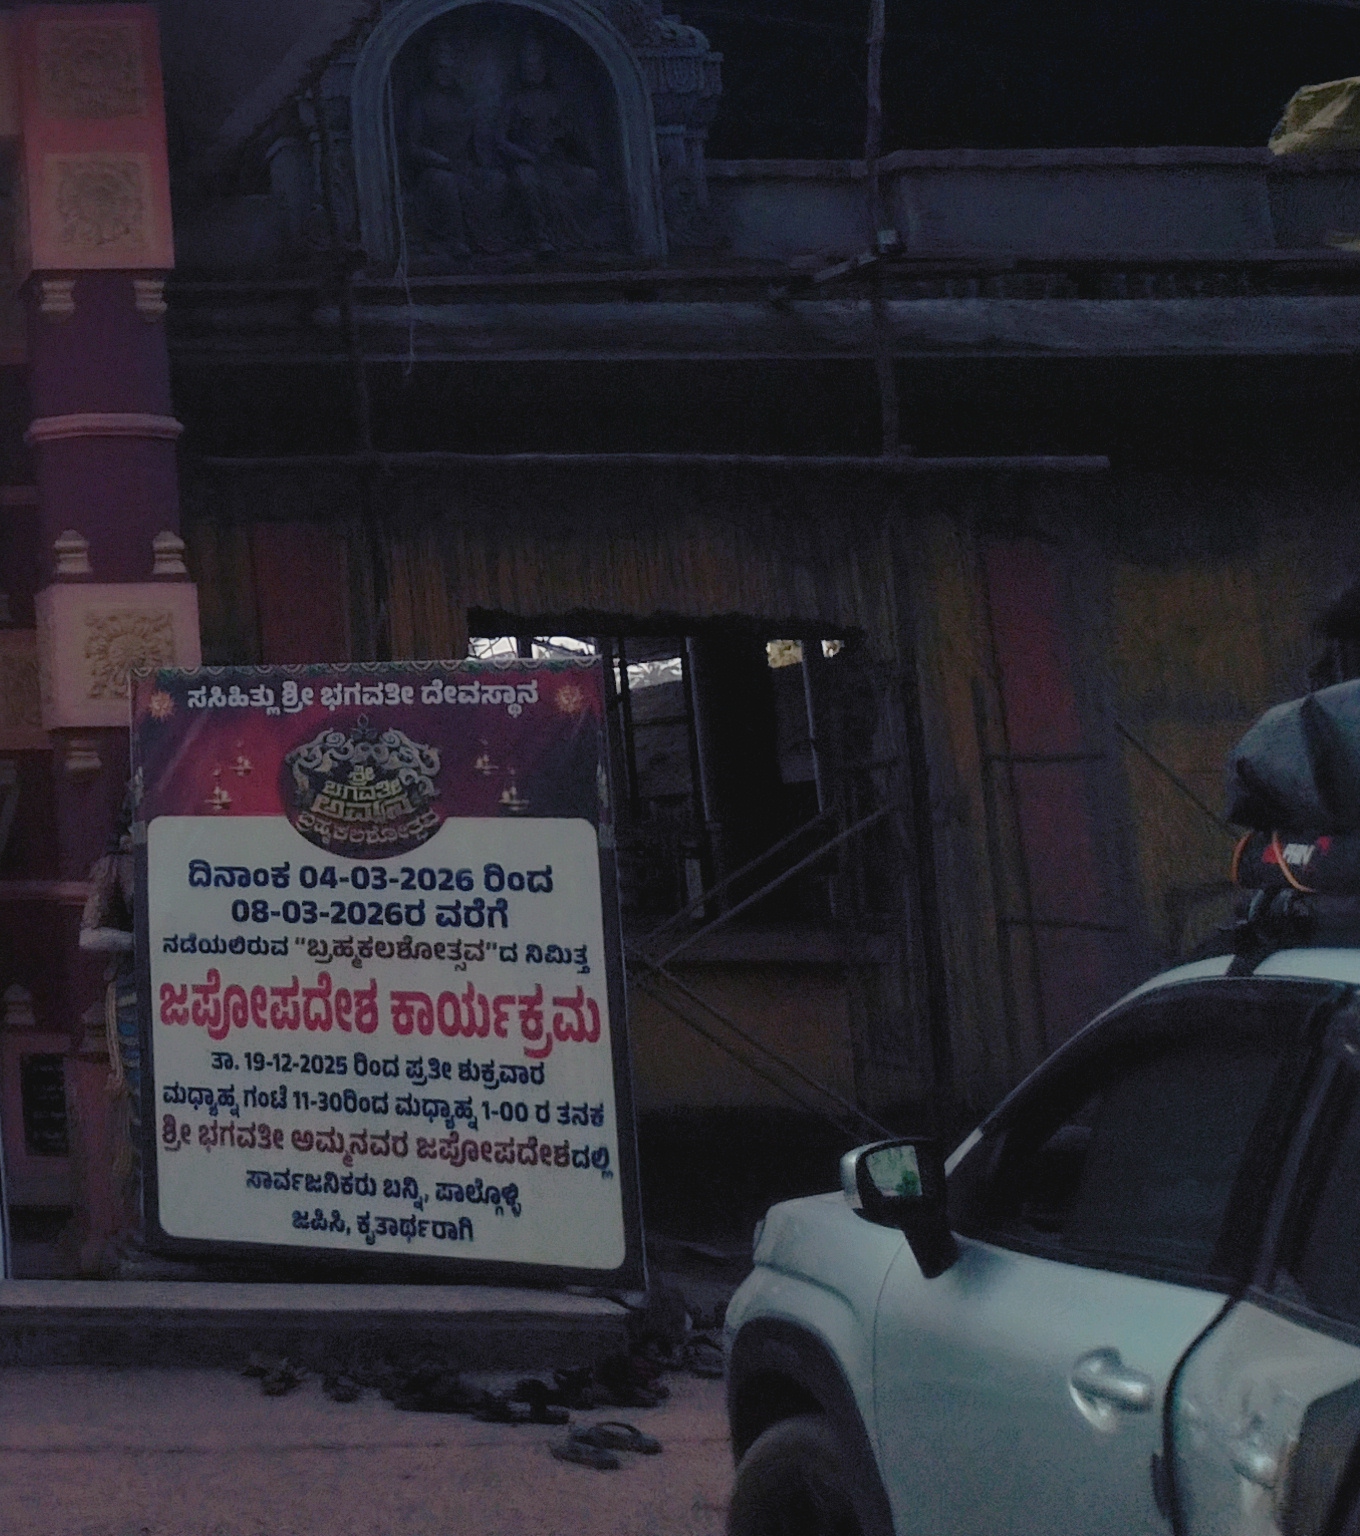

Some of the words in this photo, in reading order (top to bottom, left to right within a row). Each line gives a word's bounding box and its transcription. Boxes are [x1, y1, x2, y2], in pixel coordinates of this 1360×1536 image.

[188, 686, 281, 715] ಸಸಿಹಿತ್ಲು
[281, 681, 314, 712] ಶ್ರೀ
[321, 682, 414, 711] ಭಗವತೀ
[422, 679, 538, 716] ದೇವಸ್ಥಾನ
[188, 859, 291, 890] ದಿನಾಂಕ
[300, 866, 474, 892] 04-03-2026
[483, 863, 553, 893] ರಿಂದ
[232, 899, 424, 927] 08-03-2026ರ
[436, 898, 509, 928] ವರೆಗೆ
[163, 935, 288, 958] ನಡೆಯಲಿರುವ
[526, 942, 590, 974] ನಿಮಿತ್ತ
[159, 968, 379, 1040] ಜಪೋಪದೇಶ
[390, 981, 600, 1058] ಕಾರ್ಯಕ್ರಮ
[211, 1051, 240, 1071] ತಾ.
[245, 1052, 347, 1075] 19-12-2025
[354, 1053, 400, 1078] ರಿಂದ
[459, 1060, 545, 1090] ಶುಕ್ರವಾರ
[164, 1084, 240, 1118] ಮಧ್ಯಾಹ್ನ
[244, 1086, 287, 1111] ಗಂಟೆ
[293, 1091, 388, 1115] 11-30ರಿಂದ
[396, 1094, 479, 1130] ಮಧ್ಯಾಹ್ನ
[482, 1100, 528, 1122] 1-00
[535, 1102, 550, 1124] ರ
[558, 1102, 604, 1127] ತನಕ
[162, 1114, 191, 1153] ಶ್ರೀ
[198, 1119, 284, 1153] ಭಗವತೀ
[292, 1126, 408, 1168] ಅಮ್ಮನವರ
[417, 1130, 613, 1179] ಜಪೋಪದೇಶದಲ್ಲಿ
[246, 1166, 377, 1197] ಸಾರ್ವಜನಿಕರು
[292, 1208, 351, 1236] ಜಪಿಸಿ,
[357, 1213, 474, 1246] ಕೃತಾರ್ಥರಾಗಿ
